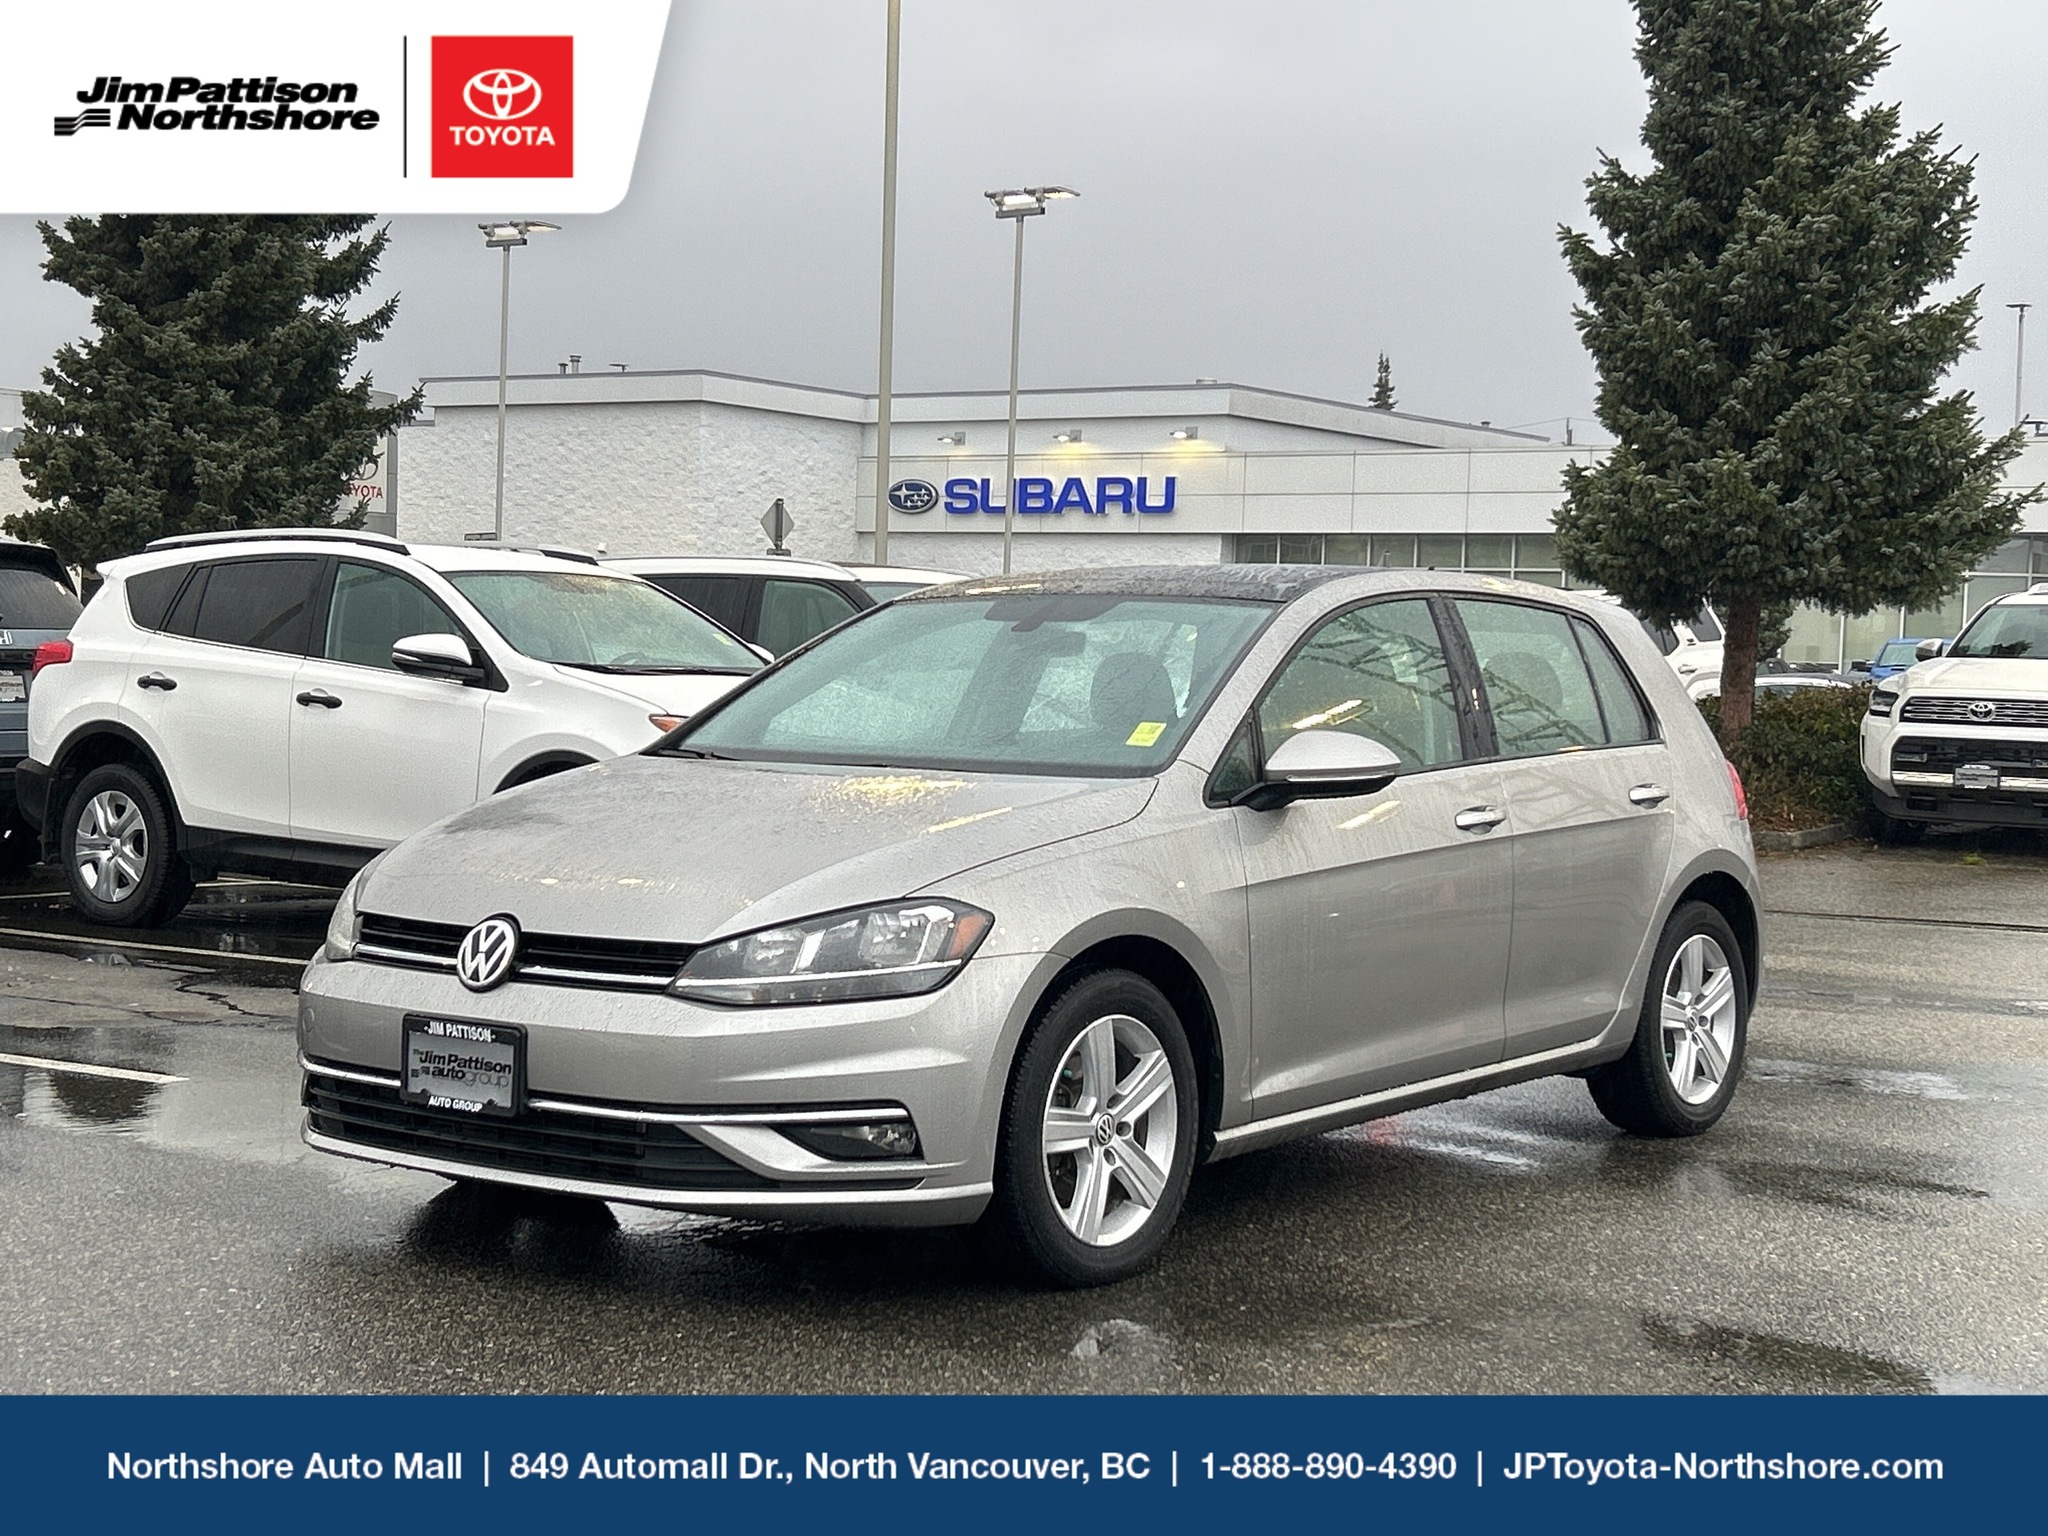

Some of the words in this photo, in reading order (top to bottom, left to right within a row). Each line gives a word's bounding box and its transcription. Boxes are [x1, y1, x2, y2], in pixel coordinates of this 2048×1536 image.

[348, 484, 383, 498] YOTA
[944, 476, 1176, 514] SUBARU
[428, 1021, 444, 1035] JIM
[446, 1024, 491, 1042] PATTISON
[419, 1050, 445, 1065] Jim
[447, 1053, 512, 1075] Pattison
[428, 1095, 451, 1108] AUTO
[452, 1100, 483, 1112] GROUP
